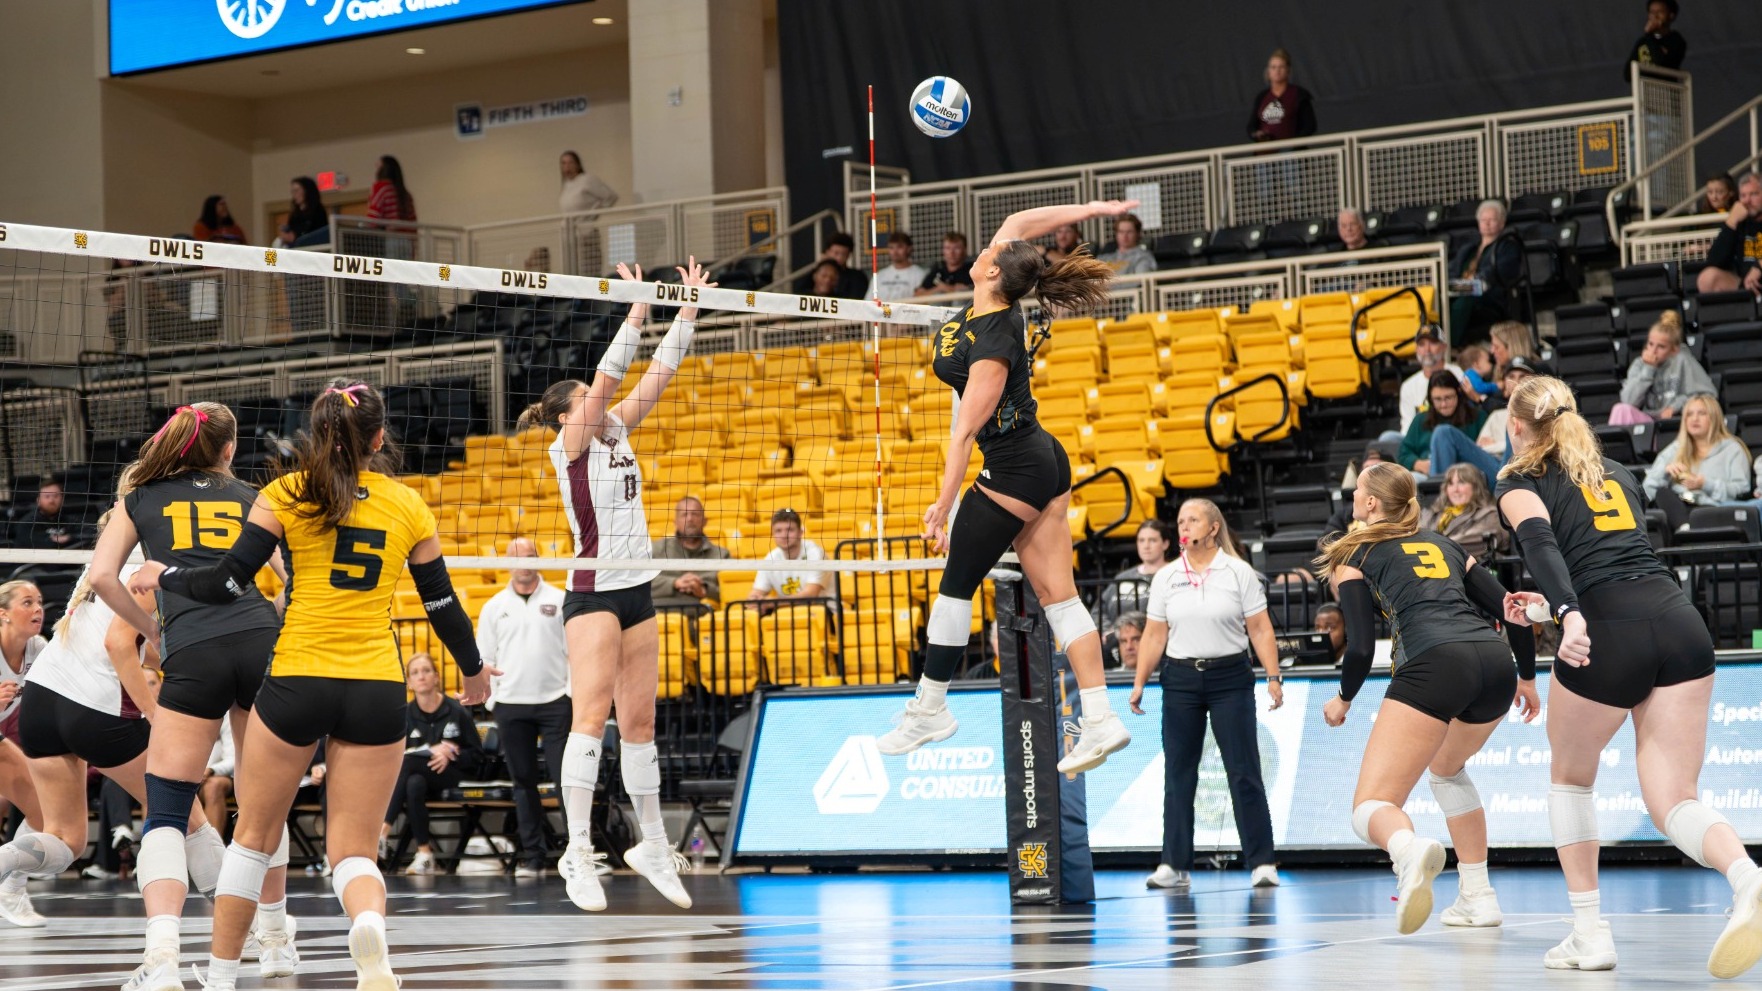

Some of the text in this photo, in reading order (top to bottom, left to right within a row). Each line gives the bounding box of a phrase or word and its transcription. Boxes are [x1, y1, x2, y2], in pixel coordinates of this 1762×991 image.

[489, 105, 533, 125] FIFTH
[541, 97, 587, 118] THIRD
[926, 101, 957, 120] molten
[150, 238, 204, 260] OWLS
[333, 255, 383, 276] OWLS
[501, 271, 547, 289] OWLS
[656, 284, 699, 303] OWLS
[799, 296, 838, 314] OWLS
[1580, 479, 1637, 532] 9
[162, 501, 243, 551] 15
[329, 525, 387, 592] 5
[1400, 542, 1451, 579] 3
[906, 746, 995, 771] UNITED
[1020, 720, 1038, 829] sports imports
[1701, 788, 1762, 809] Buildi
